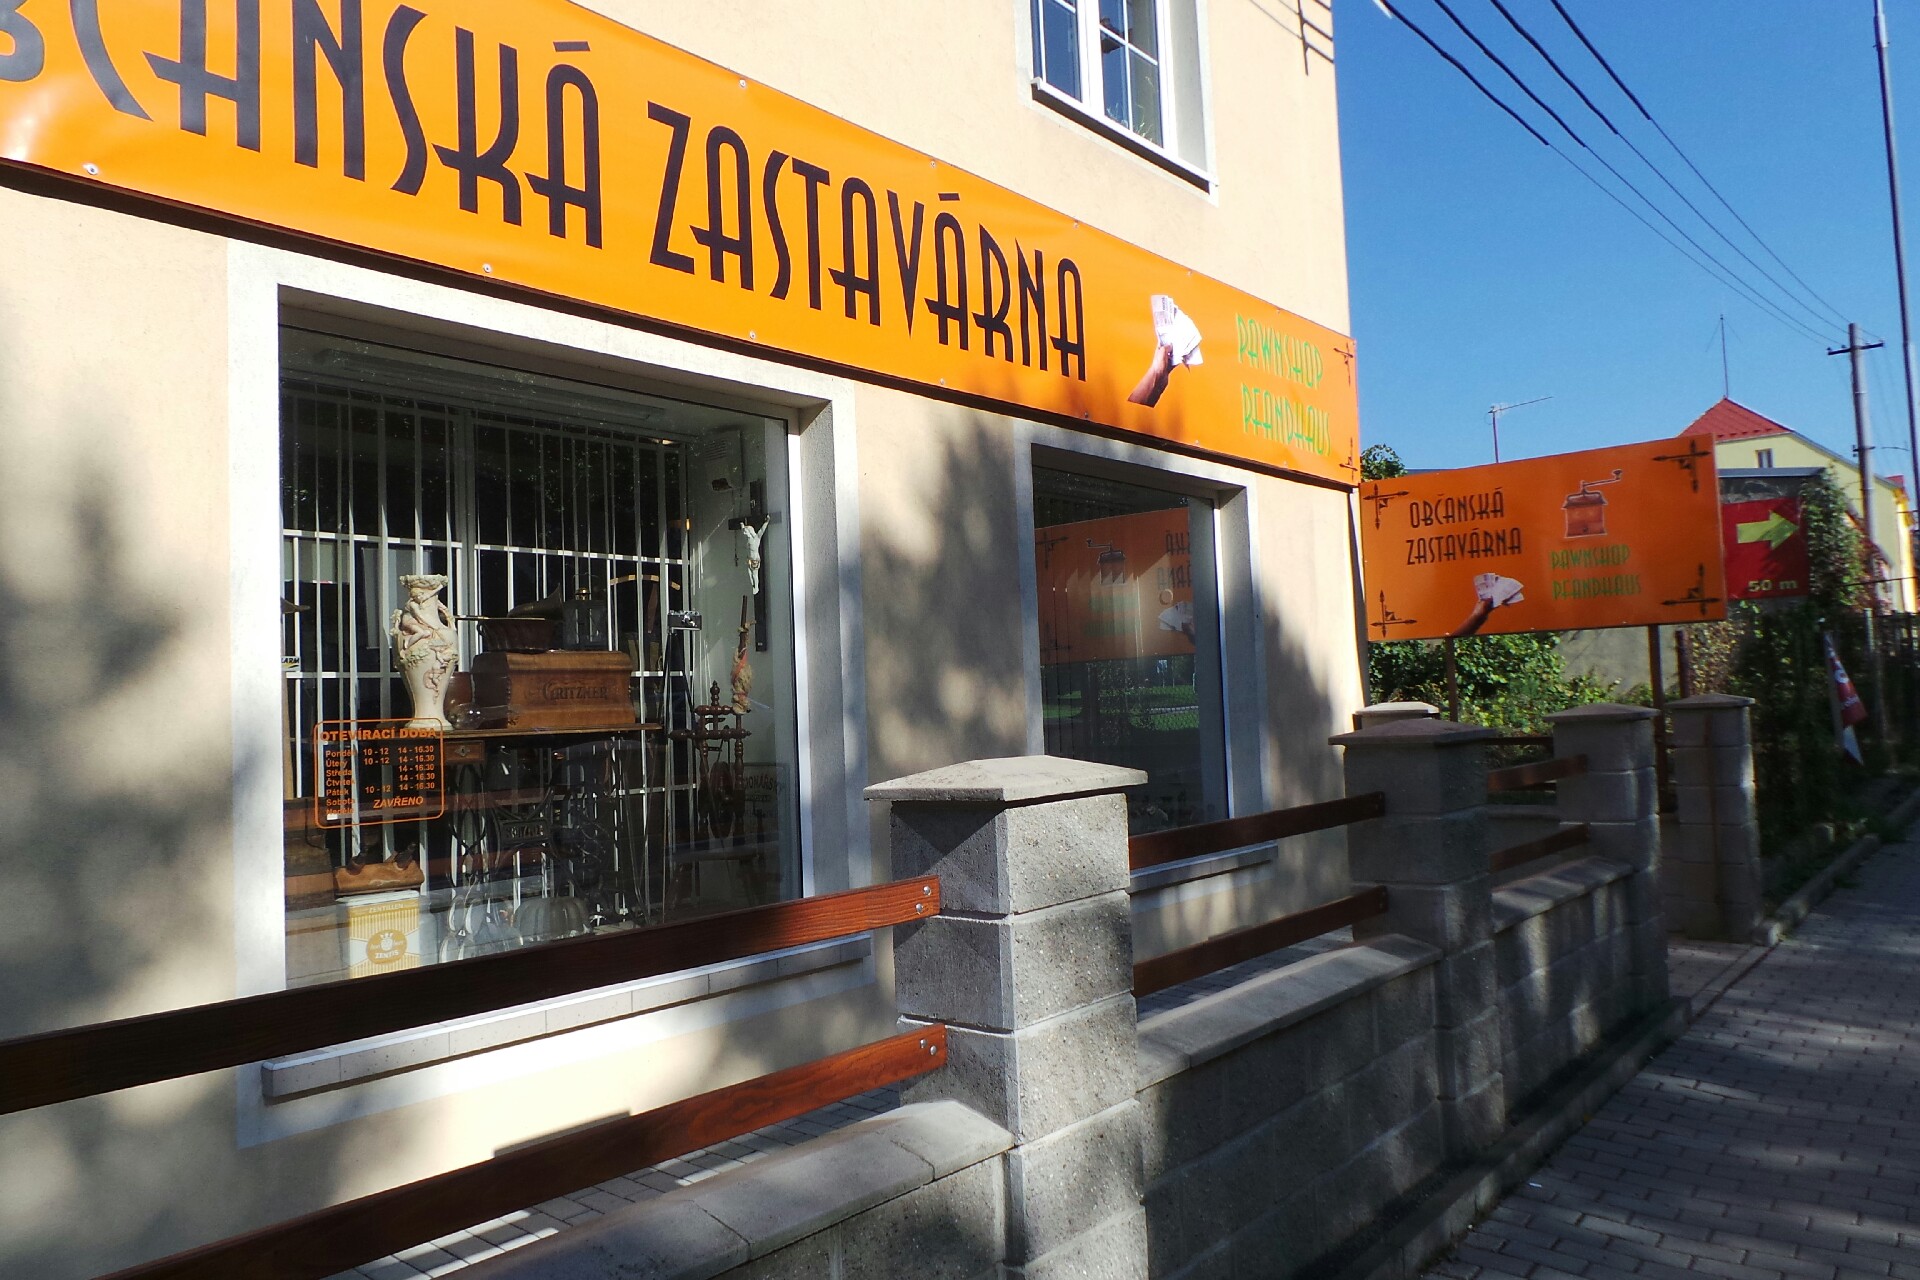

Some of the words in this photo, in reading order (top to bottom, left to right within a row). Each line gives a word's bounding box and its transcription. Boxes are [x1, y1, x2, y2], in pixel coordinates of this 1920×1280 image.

[647, 100, 1087, 383] ZASTAVÁRNA
[1236, 312, 1323, 389] PAWNSHOP
[1241, 382, 1331, 457] PFANDHAUS
[1409, 486, 1504, 528] OBČANSKÁ
[1406, 527, 1522, 565] ZASTAVÁRNA
[1550, 544, 1630, 570] PAWNSHOP
[1552, 573, 1641, 600] PFANDHAUS
[1748, 579, 1772, 592] 50
[1779, 580, 1798, 590] m
[321, 727, 395, 741] OTEVÍRACÍ
[399, 728, 436, 739] DOBA
[363, 748, 373, 756] 10
[380, 747, 389, 755] 12
[398, 746, 407, 754] 14
[414, 745, 434, 753] 16.30
[399, 755, 408, 763] 14
[415, 754, 435, 762] 16.30
[399, 764, 408, 772] 14
[414, 763, 435, 771] 16.30
[400, 774, 409, 782] 14
[415, 772, 436, 780] 16.30
[365, 785, 375, 794] 10
[382, 784, 391, 793] 12
[400, 783, 409, 791] 14
[373, 795, 424, 809] ZAVŘENO
[375, 950, 400, 959] ZENTIS
